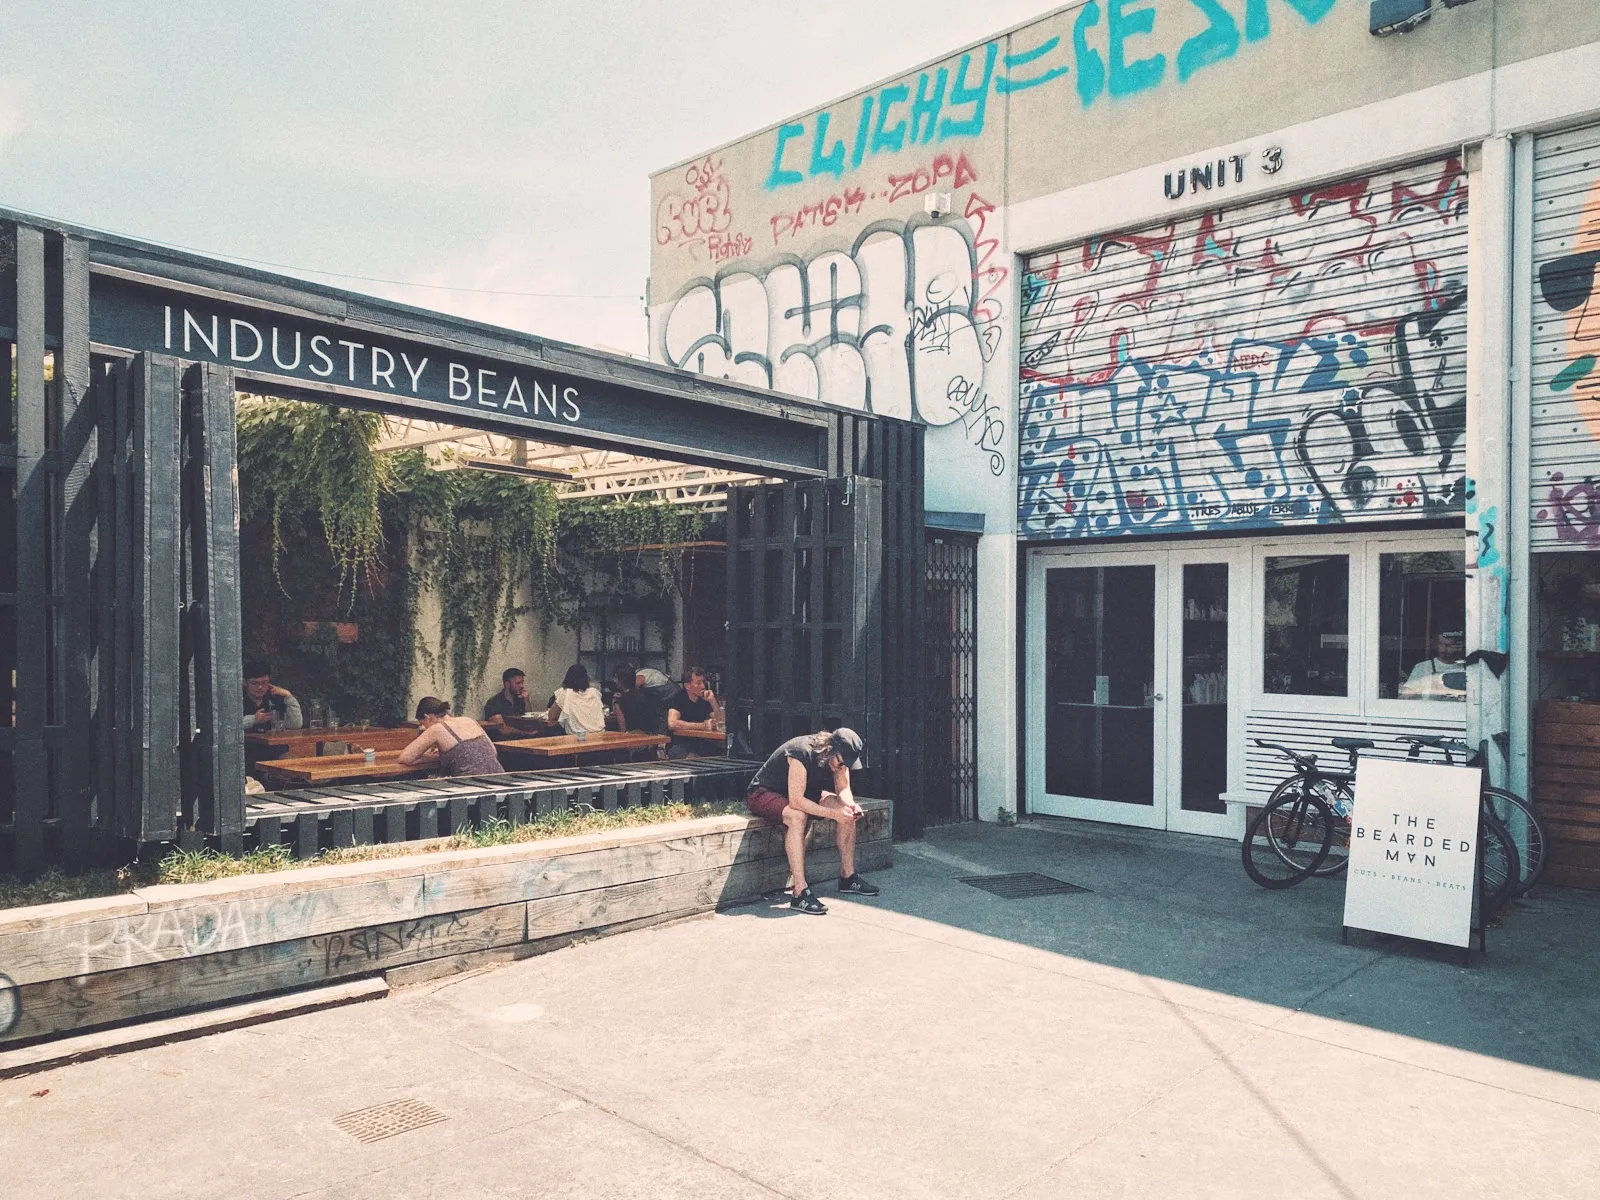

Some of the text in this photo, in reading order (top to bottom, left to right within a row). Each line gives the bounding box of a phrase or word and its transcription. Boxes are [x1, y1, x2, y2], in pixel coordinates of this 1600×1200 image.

[1164, 146, 1283, 200] UNIT 3
[164, 305, 581, 422] INDUSTRY BEANS
[1393, 813, 1435, 830] THE
[1356, 827, 1470, 853] BEARDED
[1385, 849, 1436, 867] MAN
[1353, 868, 1466, 891] CUTS BEANS BEATS
